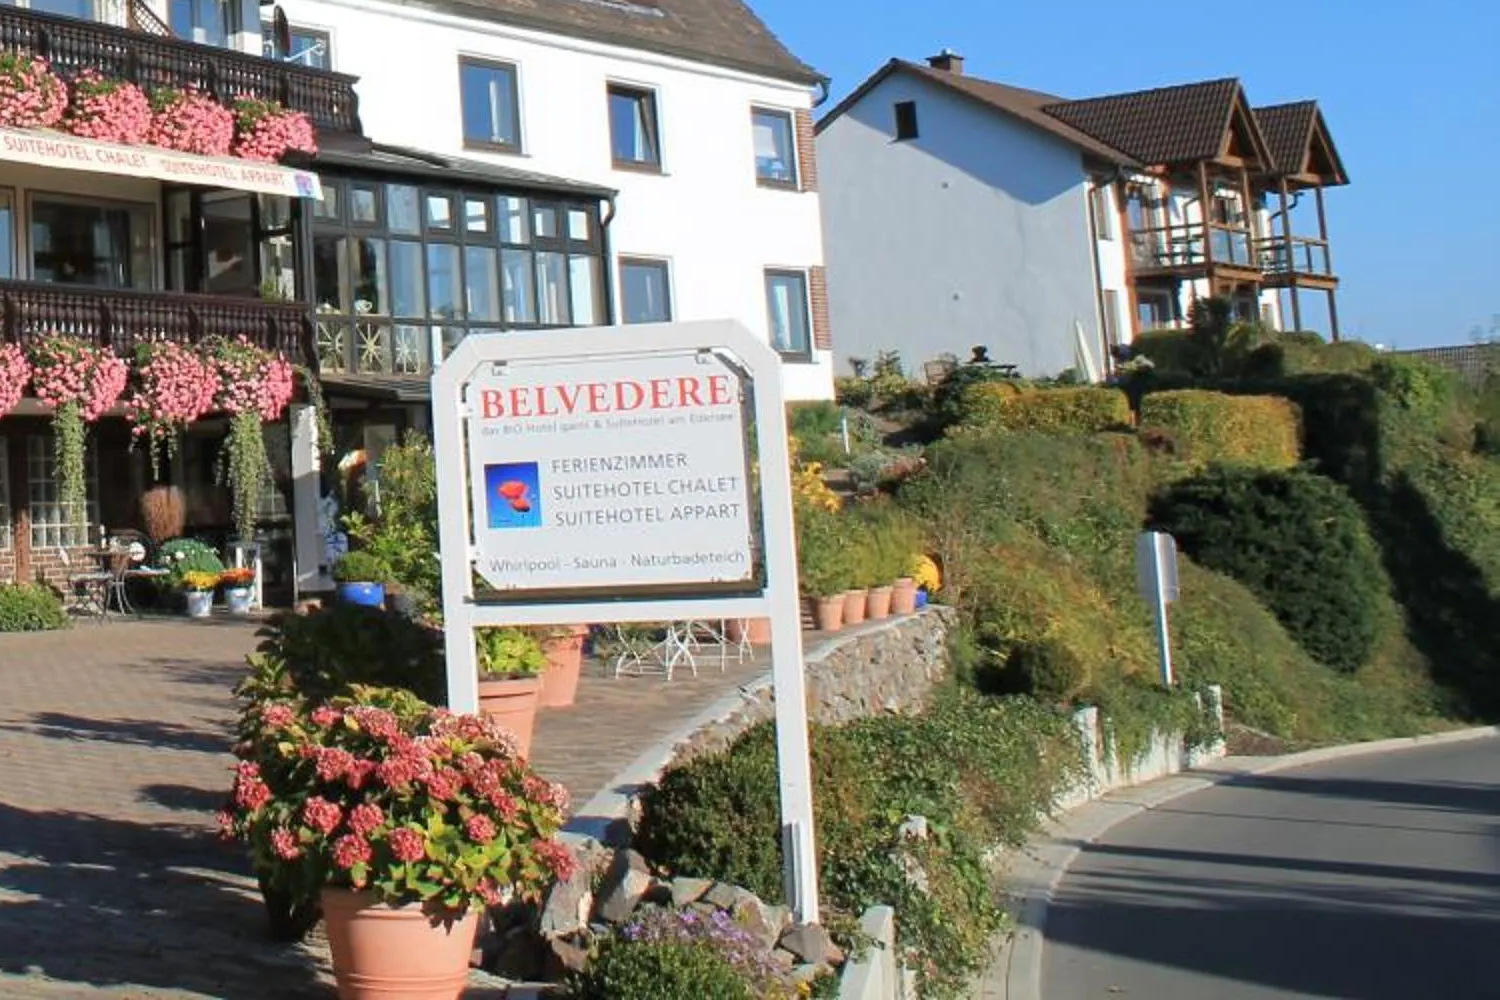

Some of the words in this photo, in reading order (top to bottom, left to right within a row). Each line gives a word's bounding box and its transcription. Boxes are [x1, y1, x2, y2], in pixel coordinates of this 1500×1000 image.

[3, 135, 92, 162] SUITEHOTEL
[95, 149, 147, 168] CHALET
[480, 374, 733, 420] BELVEDERE
[552, 452, 688, 474] FERIENZIMMER
[553, 481, 664, 501] SUITEHOTEL
[667, 476, 739, 495] CHALET
[555, 508, 665, 527] SUITEHOTEL
[670, 503, 740, 521] APPART
[490, 557, 560, 573] Whirlpool
[573, 556, 617, 570] Sauna
[631, 550, 745, 569] Naturbadeteich
